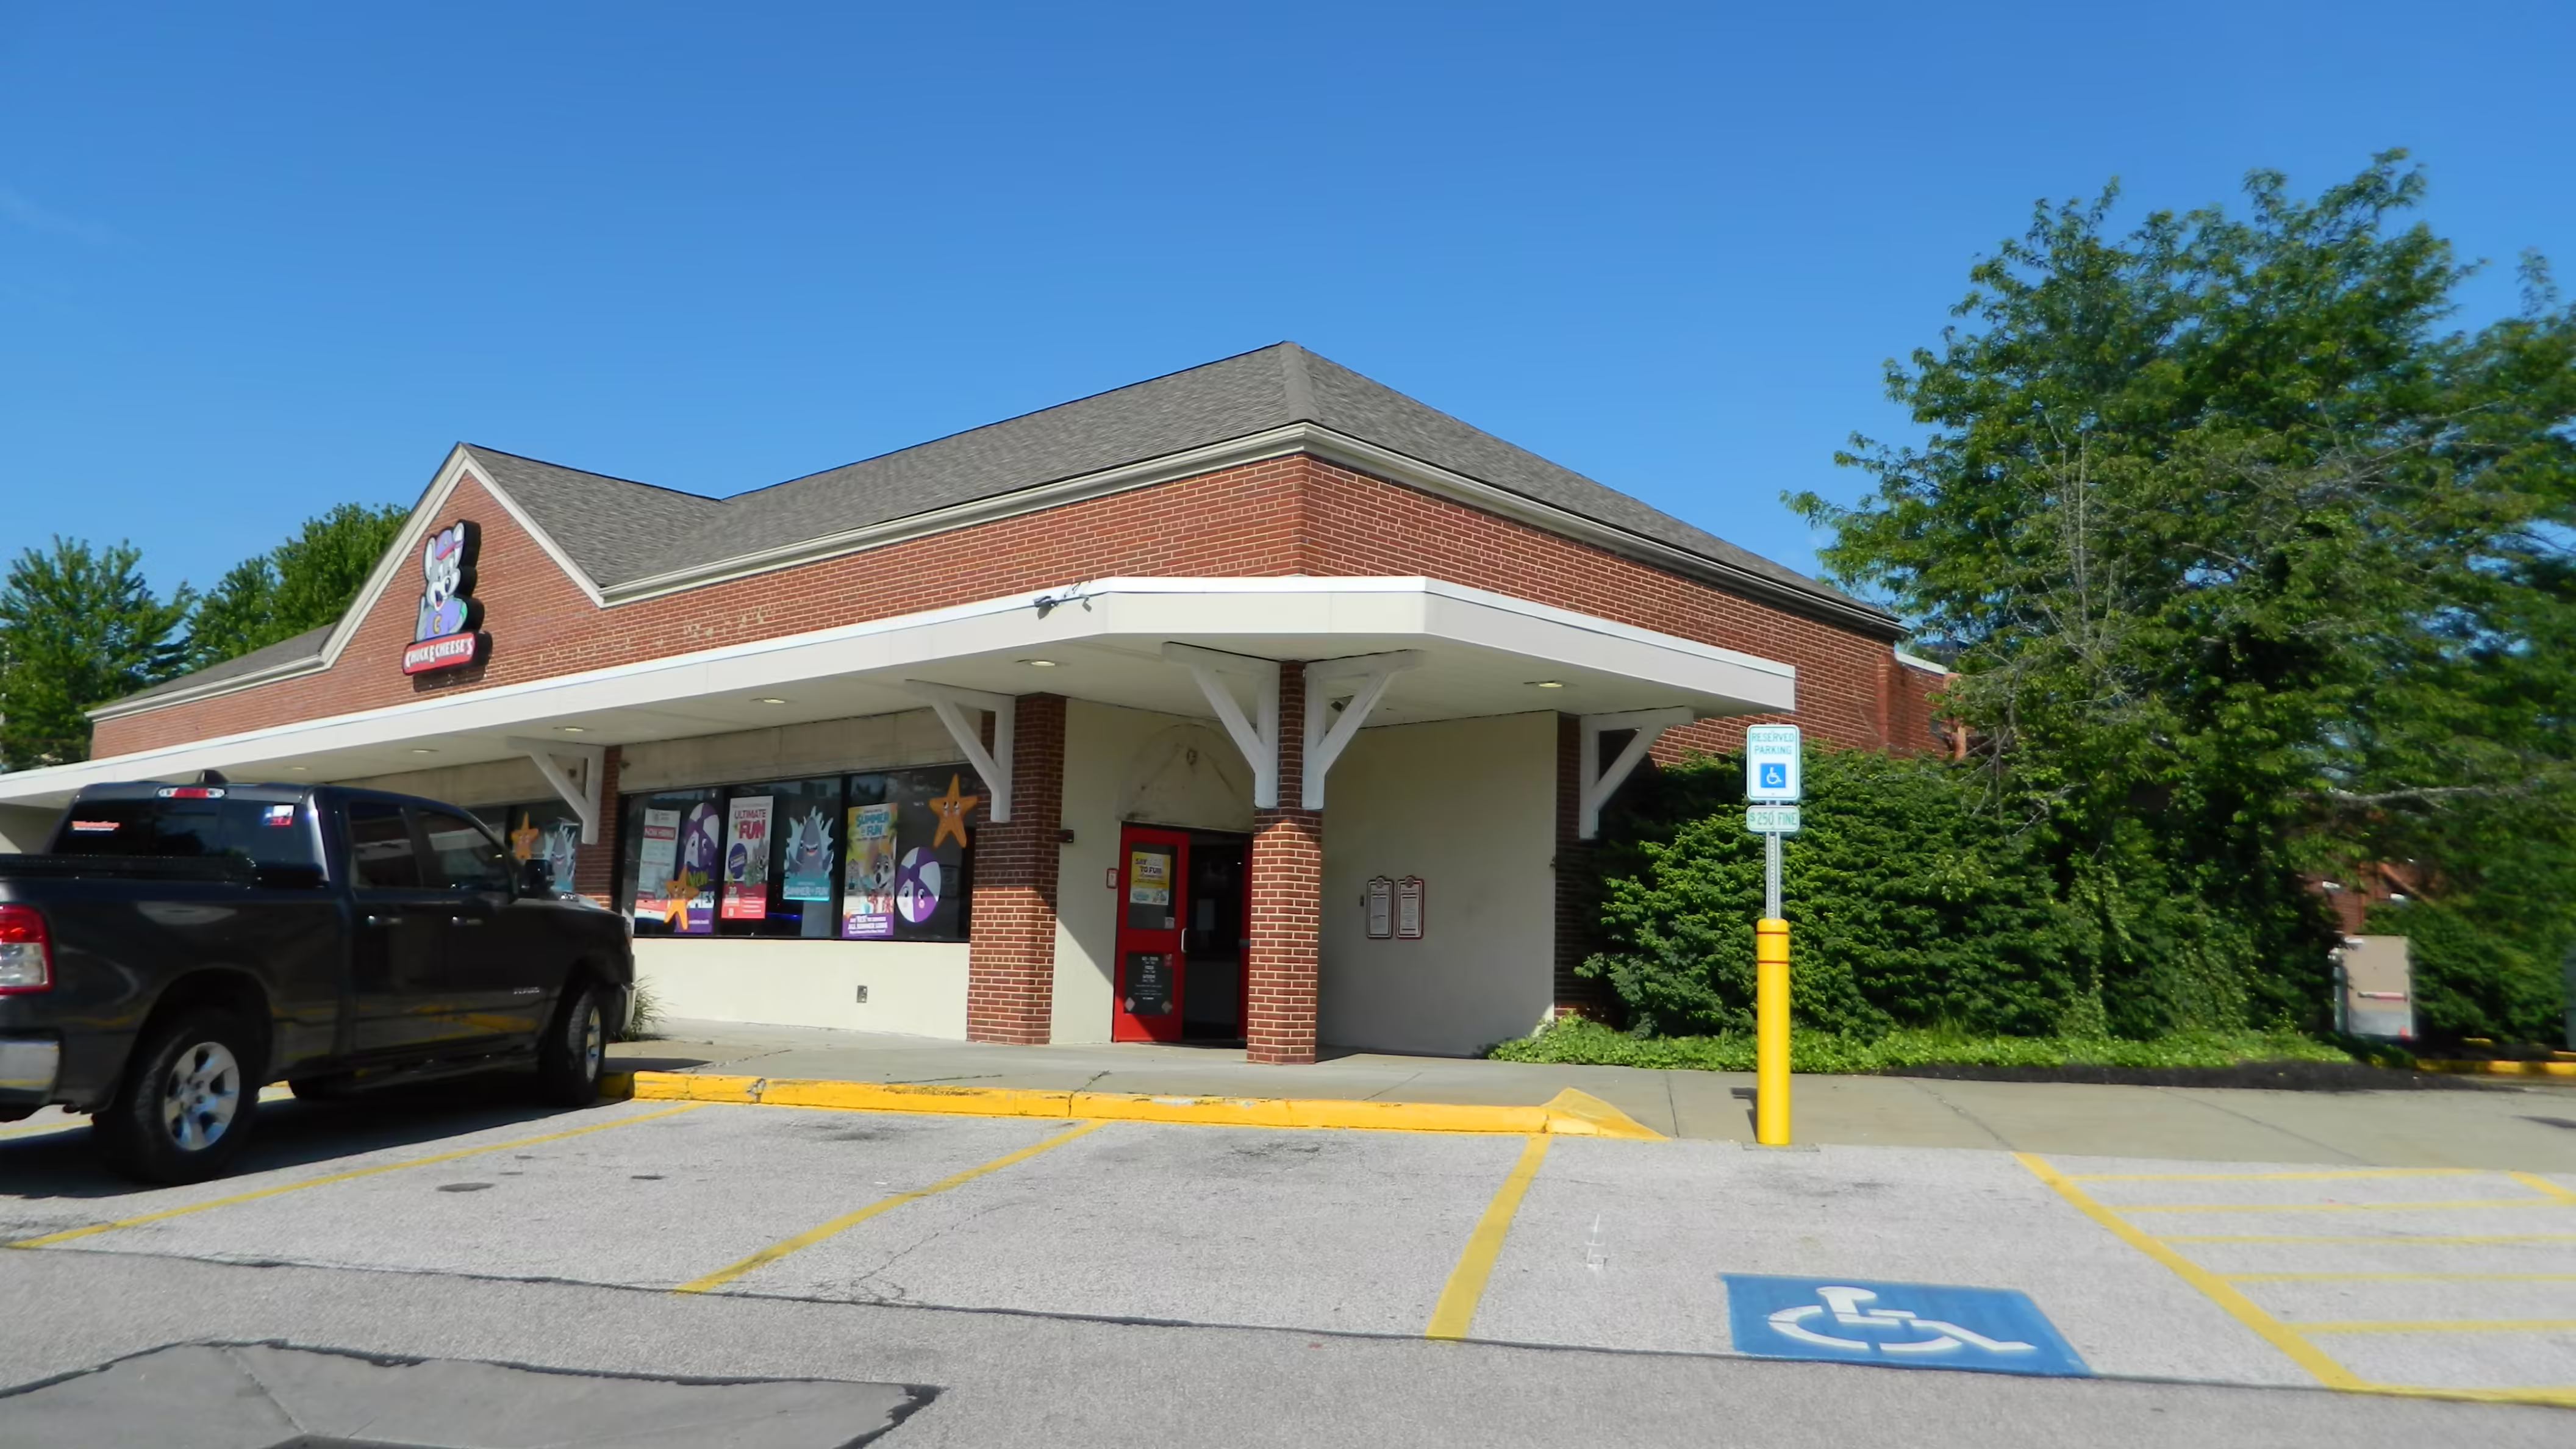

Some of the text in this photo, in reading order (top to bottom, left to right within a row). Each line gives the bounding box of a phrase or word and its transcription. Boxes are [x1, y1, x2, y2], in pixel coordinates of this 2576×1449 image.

[405, 637, 473, 668] CHUCK E CHEESE'S
[1751, 732, 1794, 742] RESERVED
[1755, 745, 1792, 754] PARKING
[734, 809, 766, 819] ULTIMATE
[856, 811, 889, 828] SUMMER
[1778, 812, 1797, 825] FINE
[739, 819, 766, 840] FUN
[867, 824, 883, 837] FUN
[784, 886, 811, 897] SUMMER
[815, 886, 829, 896] FUN
